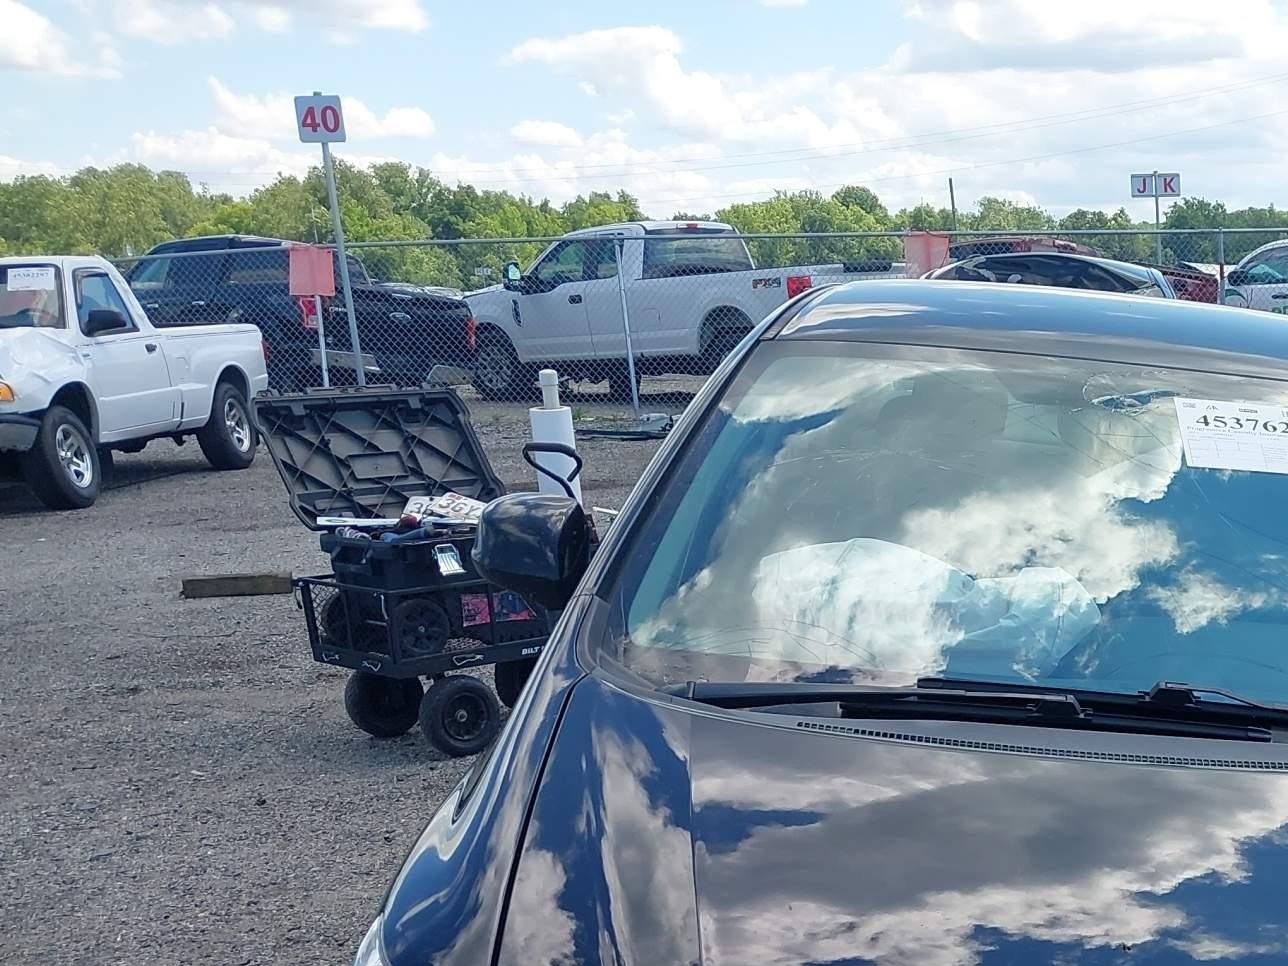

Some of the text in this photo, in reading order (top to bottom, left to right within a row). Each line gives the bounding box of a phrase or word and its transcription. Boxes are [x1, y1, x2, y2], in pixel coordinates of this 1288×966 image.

[301, 105, 340, 133] 40
[1136, 177, 1147, 194] J
[1163, 176, 1176, 193] K
[752, 277, 782, 289] FX4
